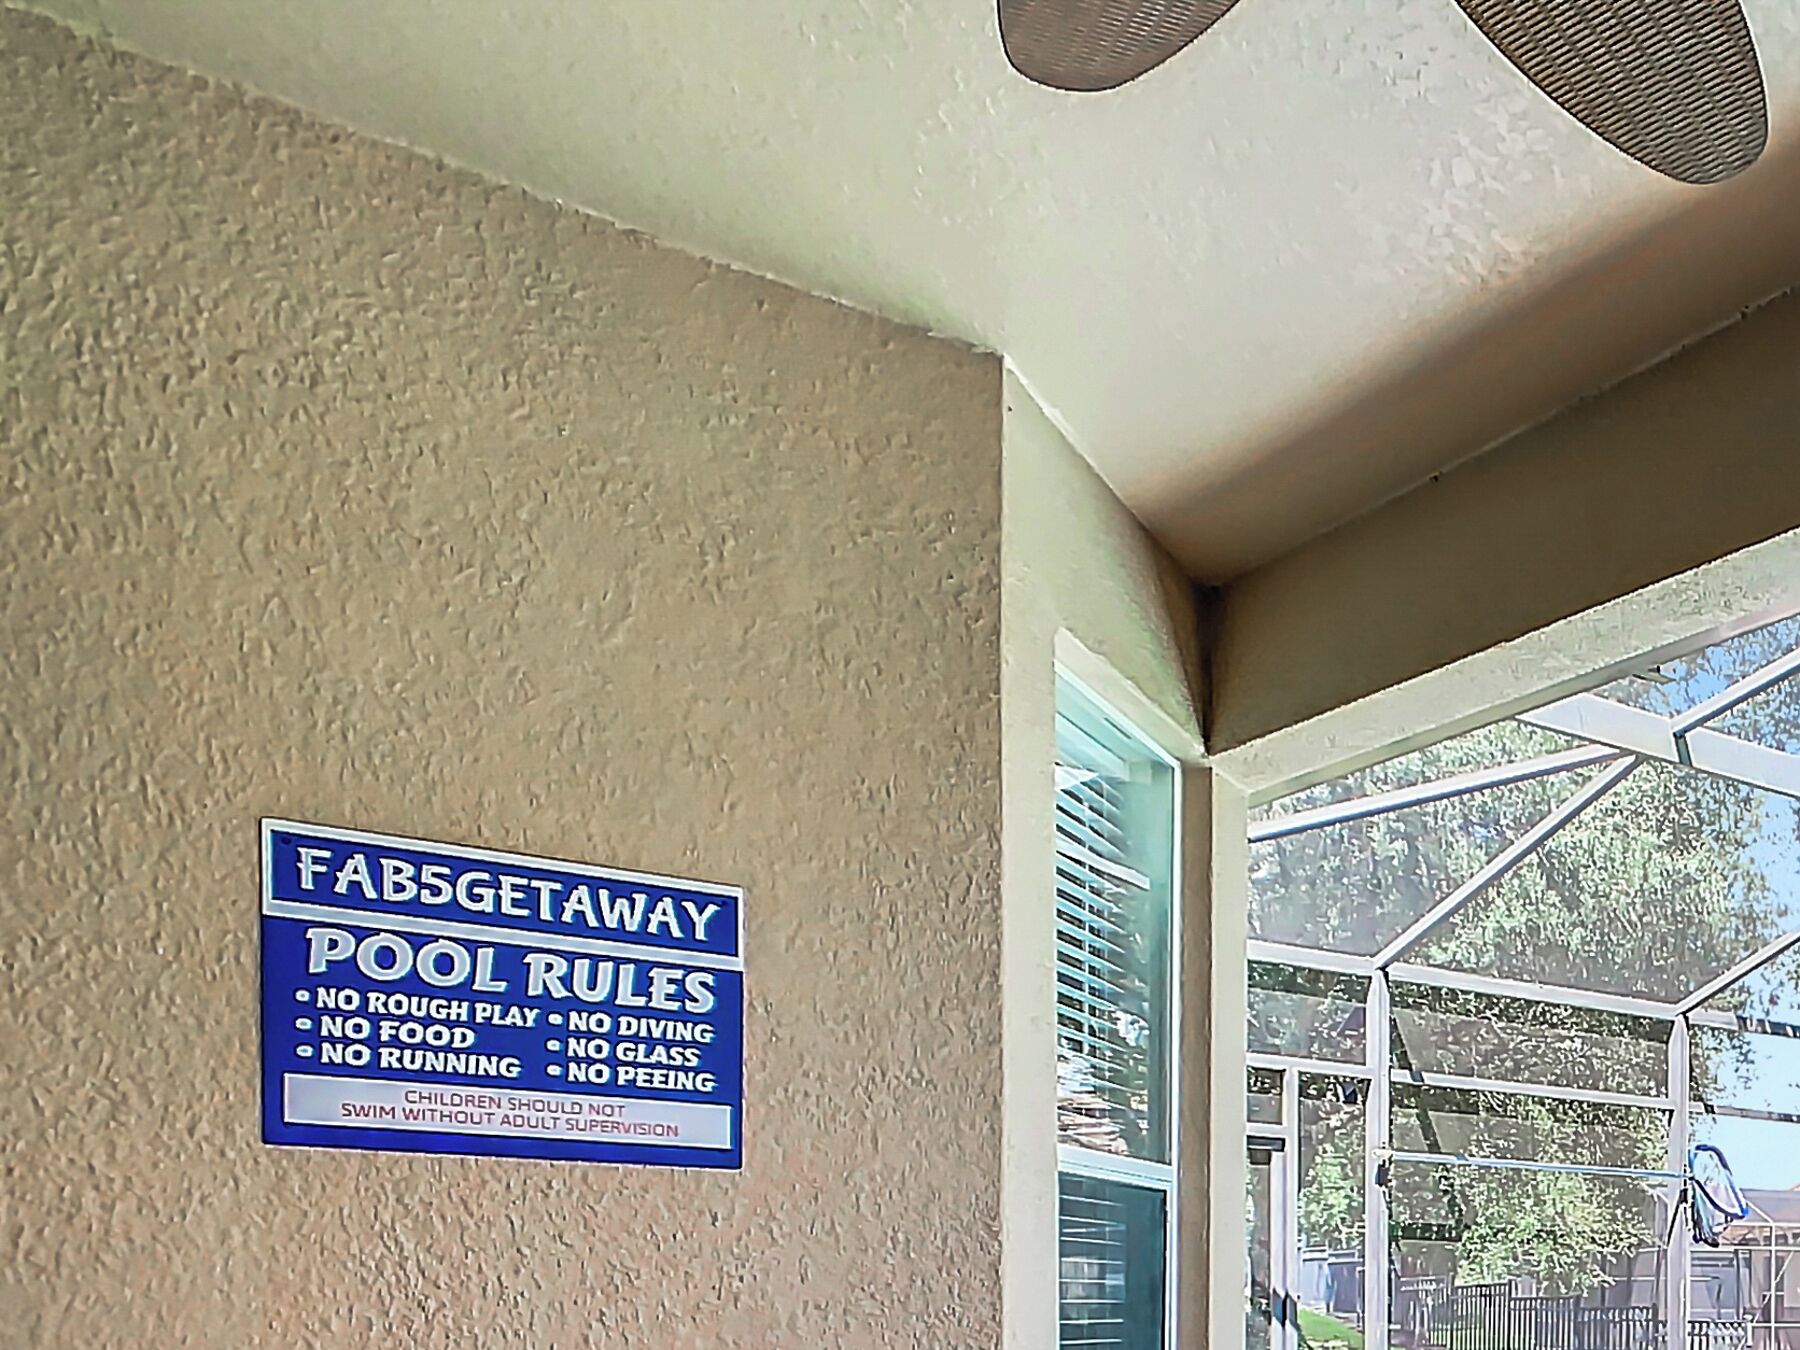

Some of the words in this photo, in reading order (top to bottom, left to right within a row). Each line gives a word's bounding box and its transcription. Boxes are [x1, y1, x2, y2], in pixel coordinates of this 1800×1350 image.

[295, 846, 723, 941] FAB5GETAWAY
[306, 927, 508, 994] POOL
[523, 953, 716, 1013] RULES
[316, 988, 360, 1011] NO
[368, 992, 469, 1022] ROUGH
[475, 1003, 541, 1027] PLAY
[320, 1016, 370, 1040] NO
[379, 1021, 476, 1049] FOOD
[567, 1012, 611, 1033] NO
[618, 1016, 715, 1044] DIVING
[321, 1044, 371, 1066] NO
[379, 1049, 522, 1078] RUNNING
[567, 1037, 610, 1060] NO
[616, 1042, 701, 1067] GLASS
[567, 1062, 610, 1084] NO
[617, 1067, 716, 1092] PEEING
[341, 1102, 397, 1119] SWIM
[402, 1106, 494, 1126] WITHOUT
[500, 1114, 559, 1131] ADULT
[566, 1117, 679, 1138] SUPERVISION
[404, 1090, 502, 1110] CHILDREN
[508, 1097, 583, 1115] SHOULD
[588, 1102, 624, 1118] NOT
